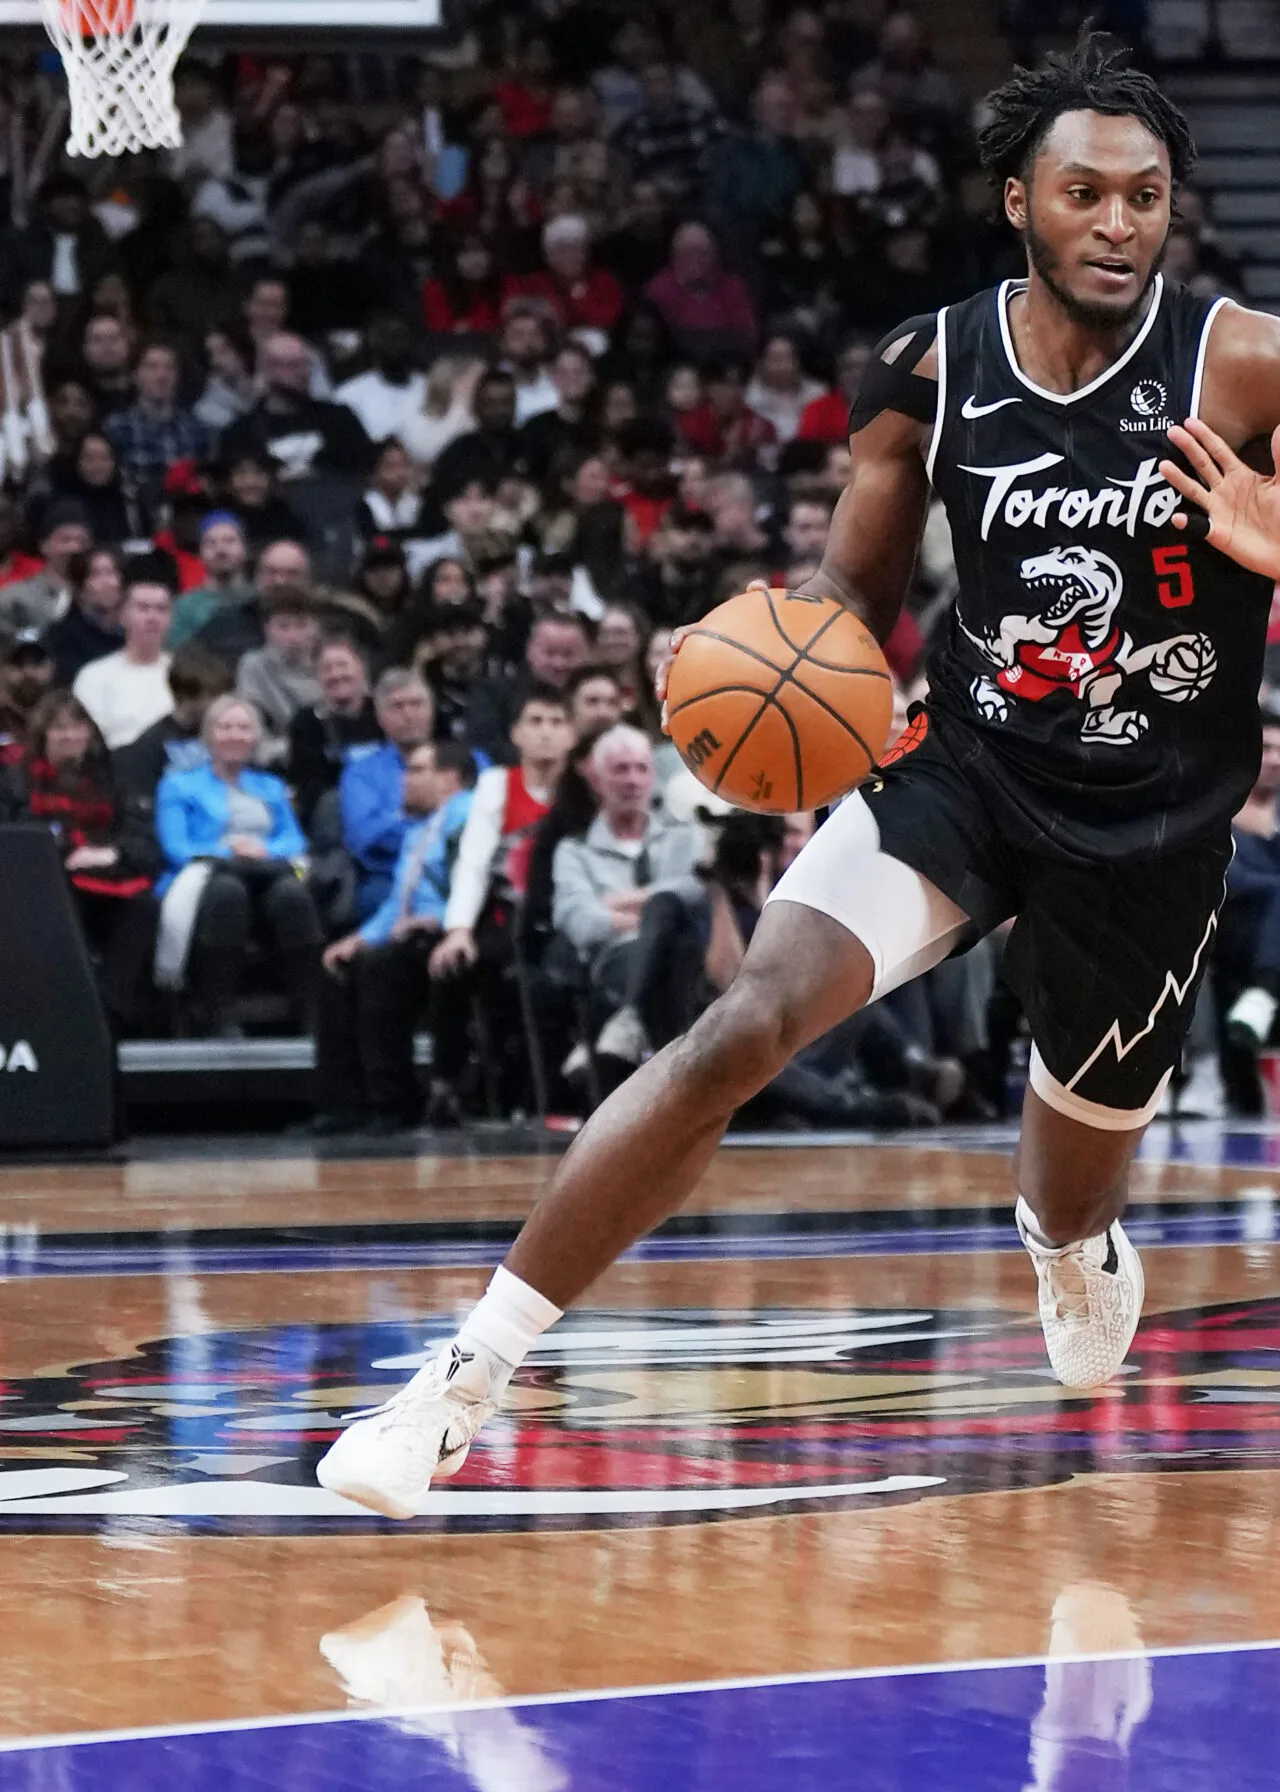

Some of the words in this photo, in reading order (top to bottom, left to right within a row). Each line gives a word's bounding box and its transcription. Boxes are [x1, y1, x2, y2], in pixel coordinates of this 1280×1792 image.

[1119, 418, 1147, 432] Sun
[956, 452, 1183, 542] Toronto
[1151, 544, 1195, 609] 5
